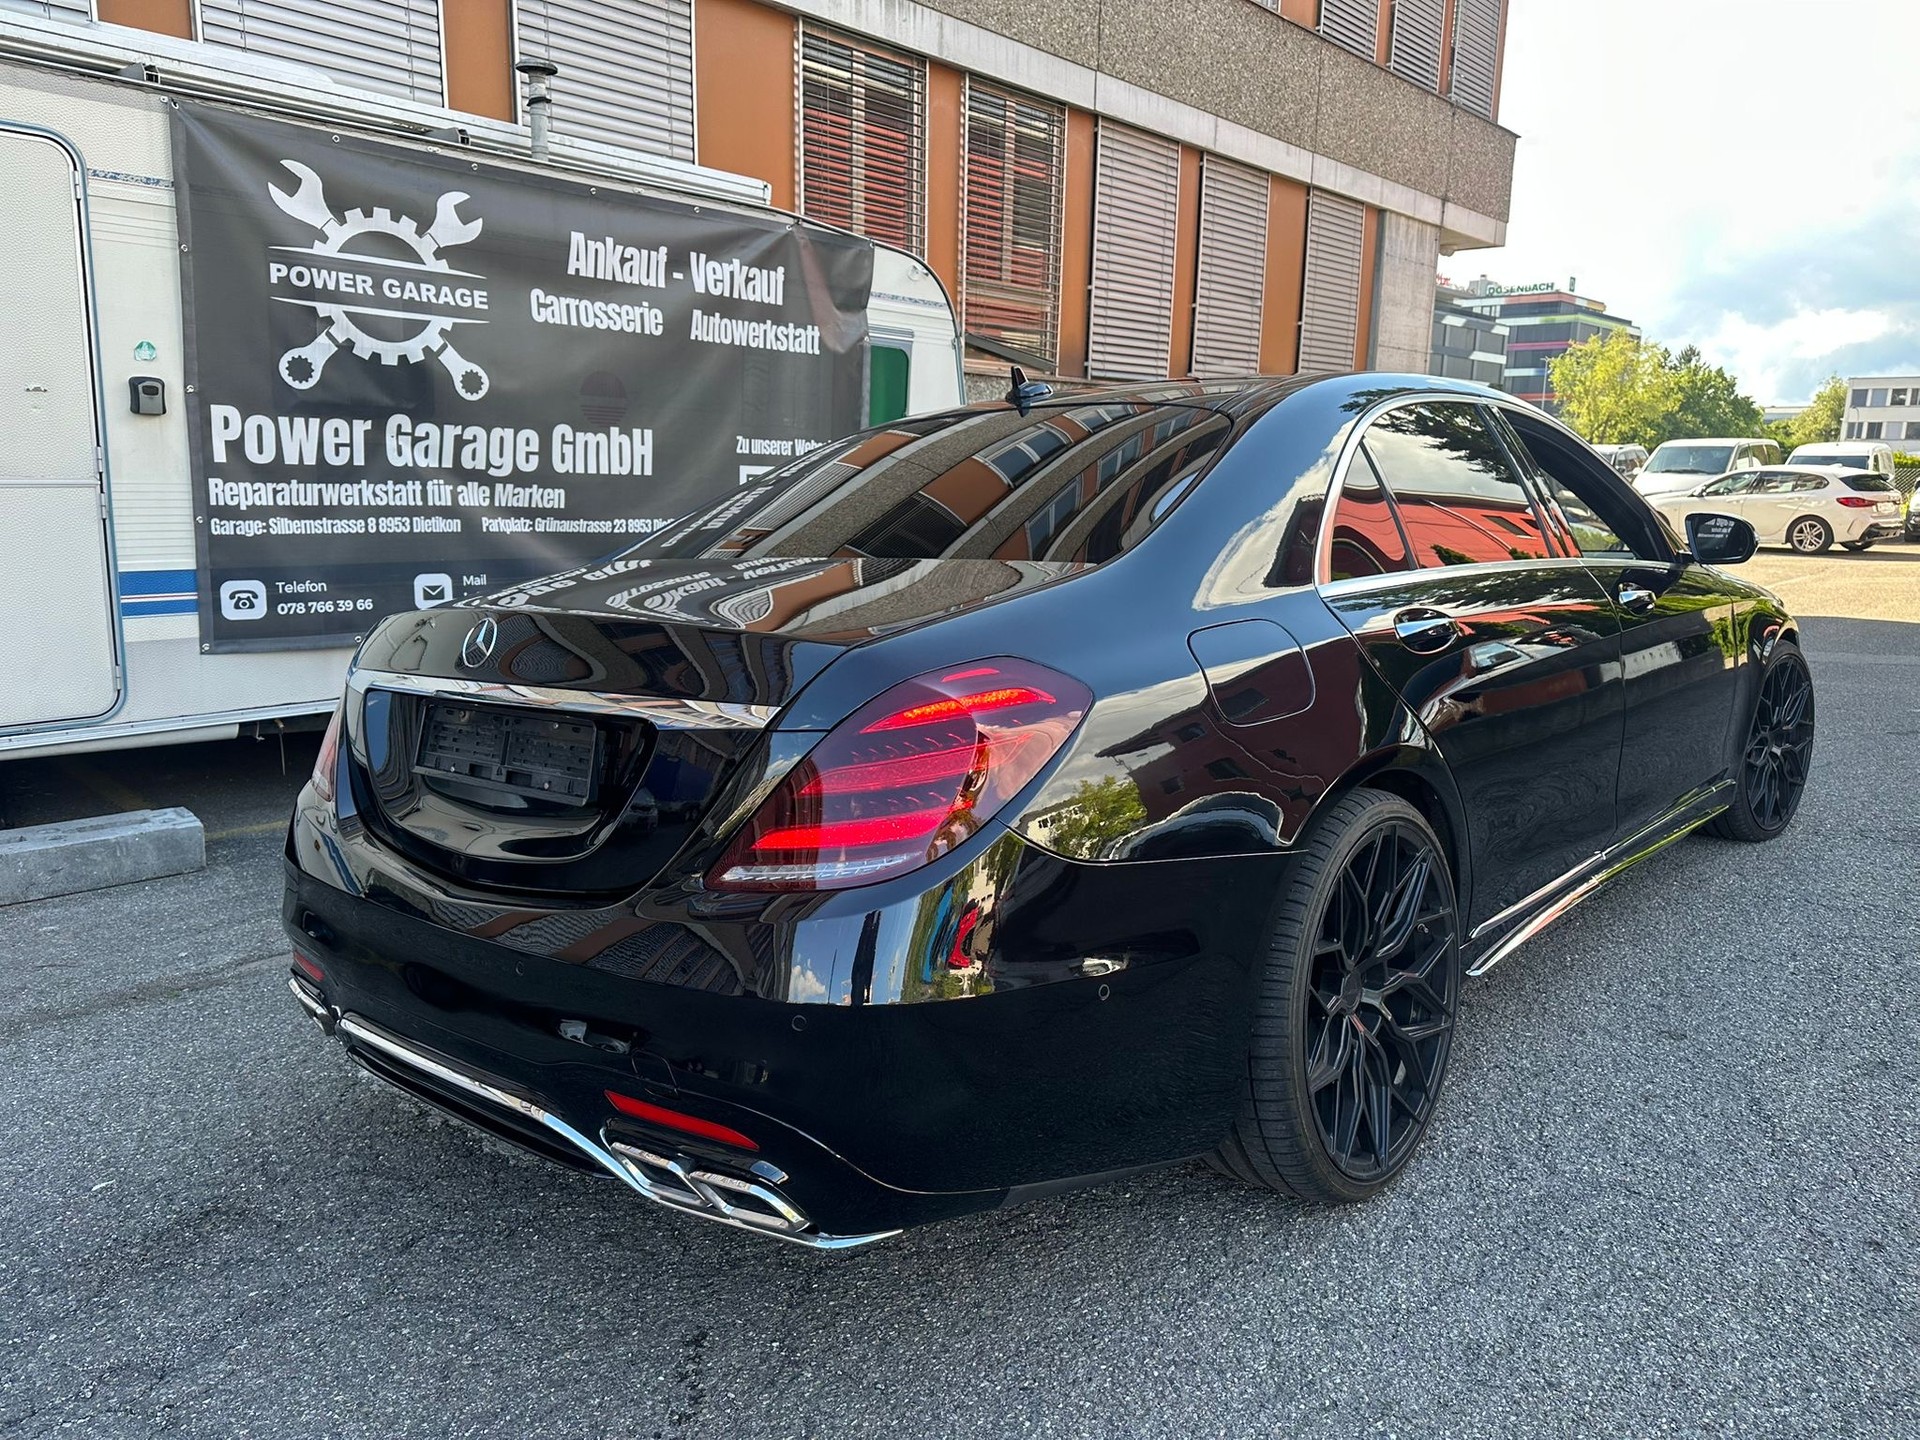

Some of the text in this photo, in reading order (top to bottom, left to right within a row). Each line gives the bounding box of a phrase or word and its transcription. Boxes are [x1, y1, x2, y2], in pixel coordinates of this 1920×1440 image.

[568, 231, 667, 288] Ankauf
[690, 252, 784, 305] Verkauf
[269, 262, 489, 310] POWER GARAGE
[530, 288, 664, 336] Carrosserie
[690, 309, 820, 354] Autowerkstatt
[210, 404, 652, 476] Power Garage GmbH
[736, 436, 749, 453] Zu
[752, 439, 793, 455] unserer
[208, 478, 565, 510] Reparaturwerkstatt für alle Marken
[211, 516, 461, 536] Garage: Silbernstrasse 8 8953 Dietikon
[482, 517, 533, 534] Parkplatz:
[535, 517, 612, 532] Grünaustrasse
[614, 519, 626, 533] 23
[628, 519, 652, 533] 8953
[276, 580, 327, 593] Telefon
[463, 574, 486, 586] Mail
[276, 599, 373, 615] 078 766 39 66
